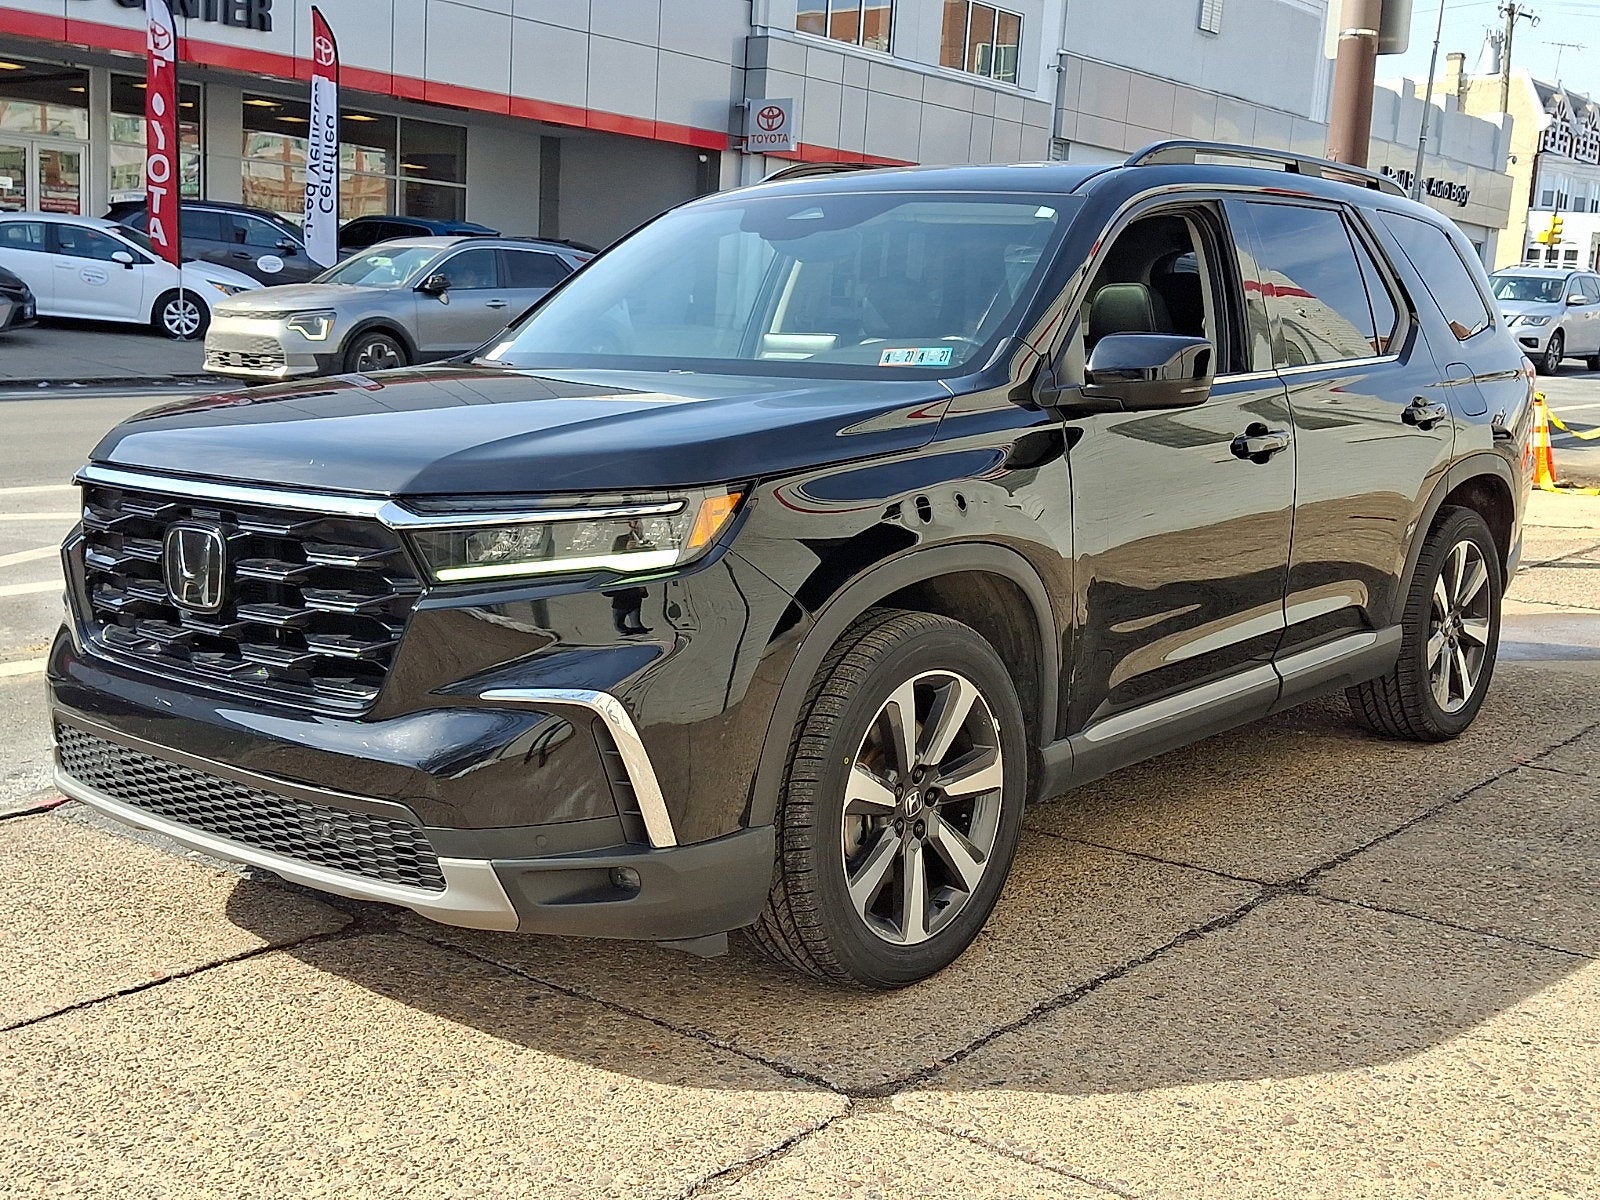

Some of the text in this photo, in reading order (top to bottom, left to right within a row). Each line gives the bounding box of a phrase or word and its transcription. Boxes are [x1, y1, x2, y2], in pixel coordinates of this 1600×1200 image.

[751, 133, 789, 144] TOYOTA
[1429, 177, 1450, 199] Auto
[1450, 182, 1470, 208] Body
[904, 350, 915, 362] 27
[939, 350, 949, 362] 27
